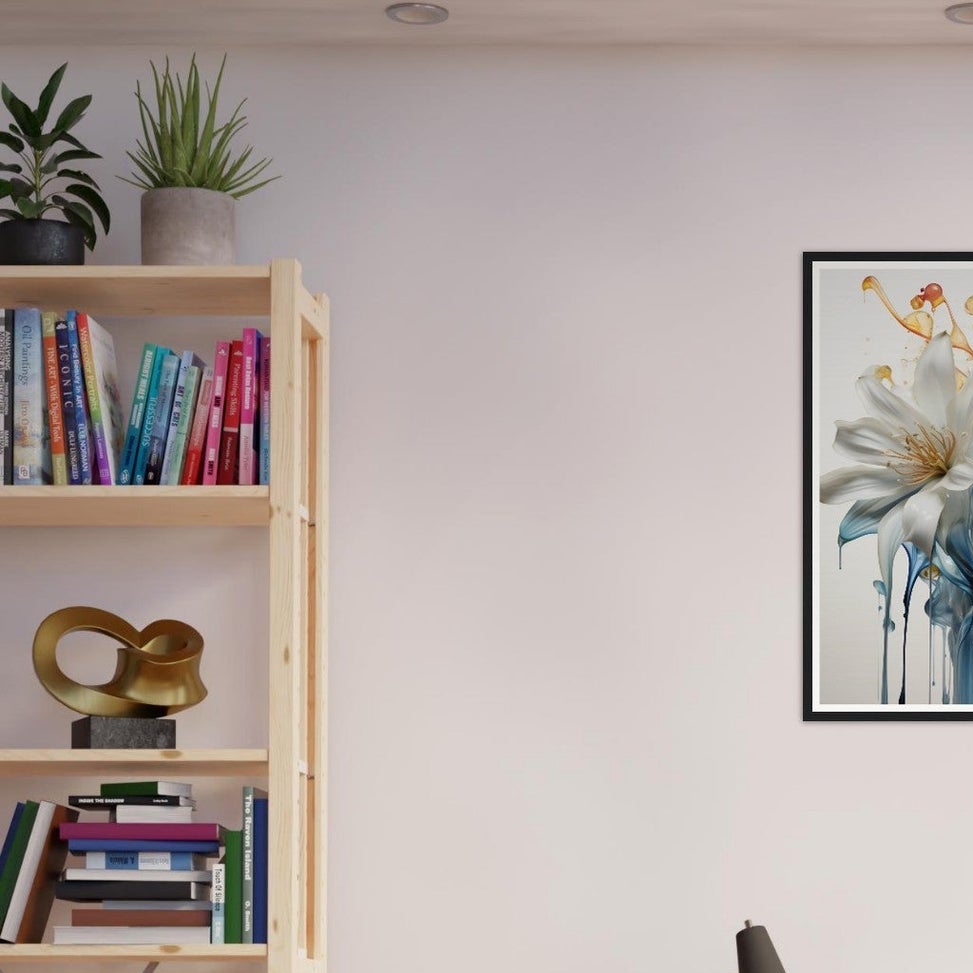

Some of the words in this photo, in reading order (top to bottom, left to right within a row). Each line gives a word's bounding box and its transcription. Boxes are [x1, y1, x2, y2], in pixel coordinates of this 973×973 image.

[23, 325, 32, 340] Oil
[20, 342, 32, 386] Paintings
[47, 347, 55, 364] FINE
[80, 327, 91, 372] Watercolor
[86, 373, 98, 410] Portraits
[48, 364, 56, 378] ART
[59, 344, 73, 408] ICONIC
[231, 363, 241, 398] Parenting
[51, 402, 59, 424] Digital
[142, 397, 156, 446] SUCCESSFUL
[52, 425, 60, 442] Tools
[244, 794, 252, 814] The
[244, 815, 252, 846] Raven
[213, 868, 222, 884] Touch
[244, 849, 252, 880] Island
